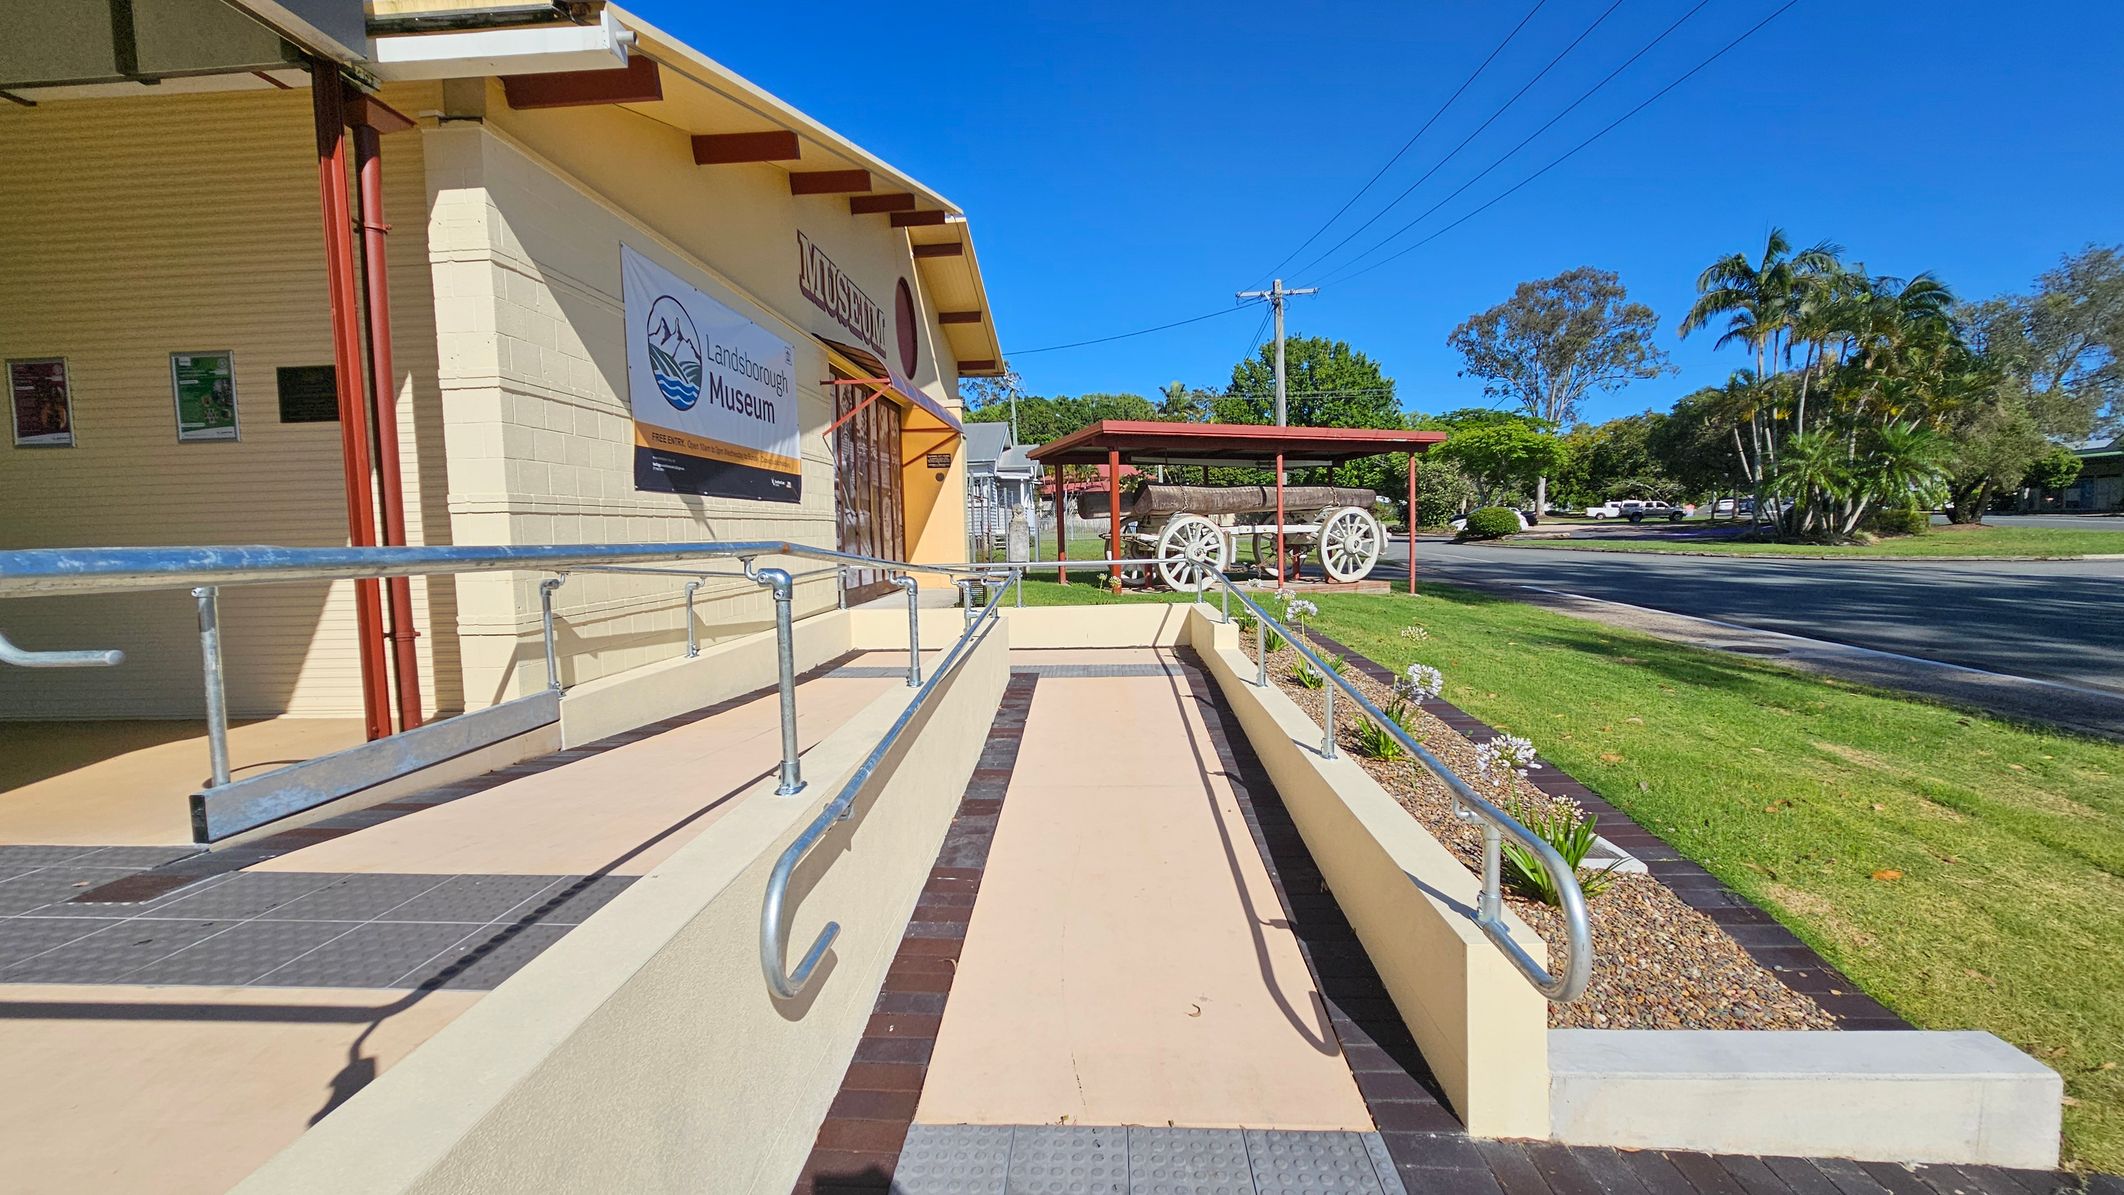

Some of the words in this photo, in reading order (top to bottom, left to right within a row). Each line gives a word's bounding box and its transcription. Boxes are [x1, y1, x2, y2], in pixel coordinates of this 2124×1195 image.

[797, 229, 886, 359] MUSEUM
[706, 334, 789, 397] Landsborough
[709, 371, 776, 425] Museum
[651, 432, 667, 444] FREE
